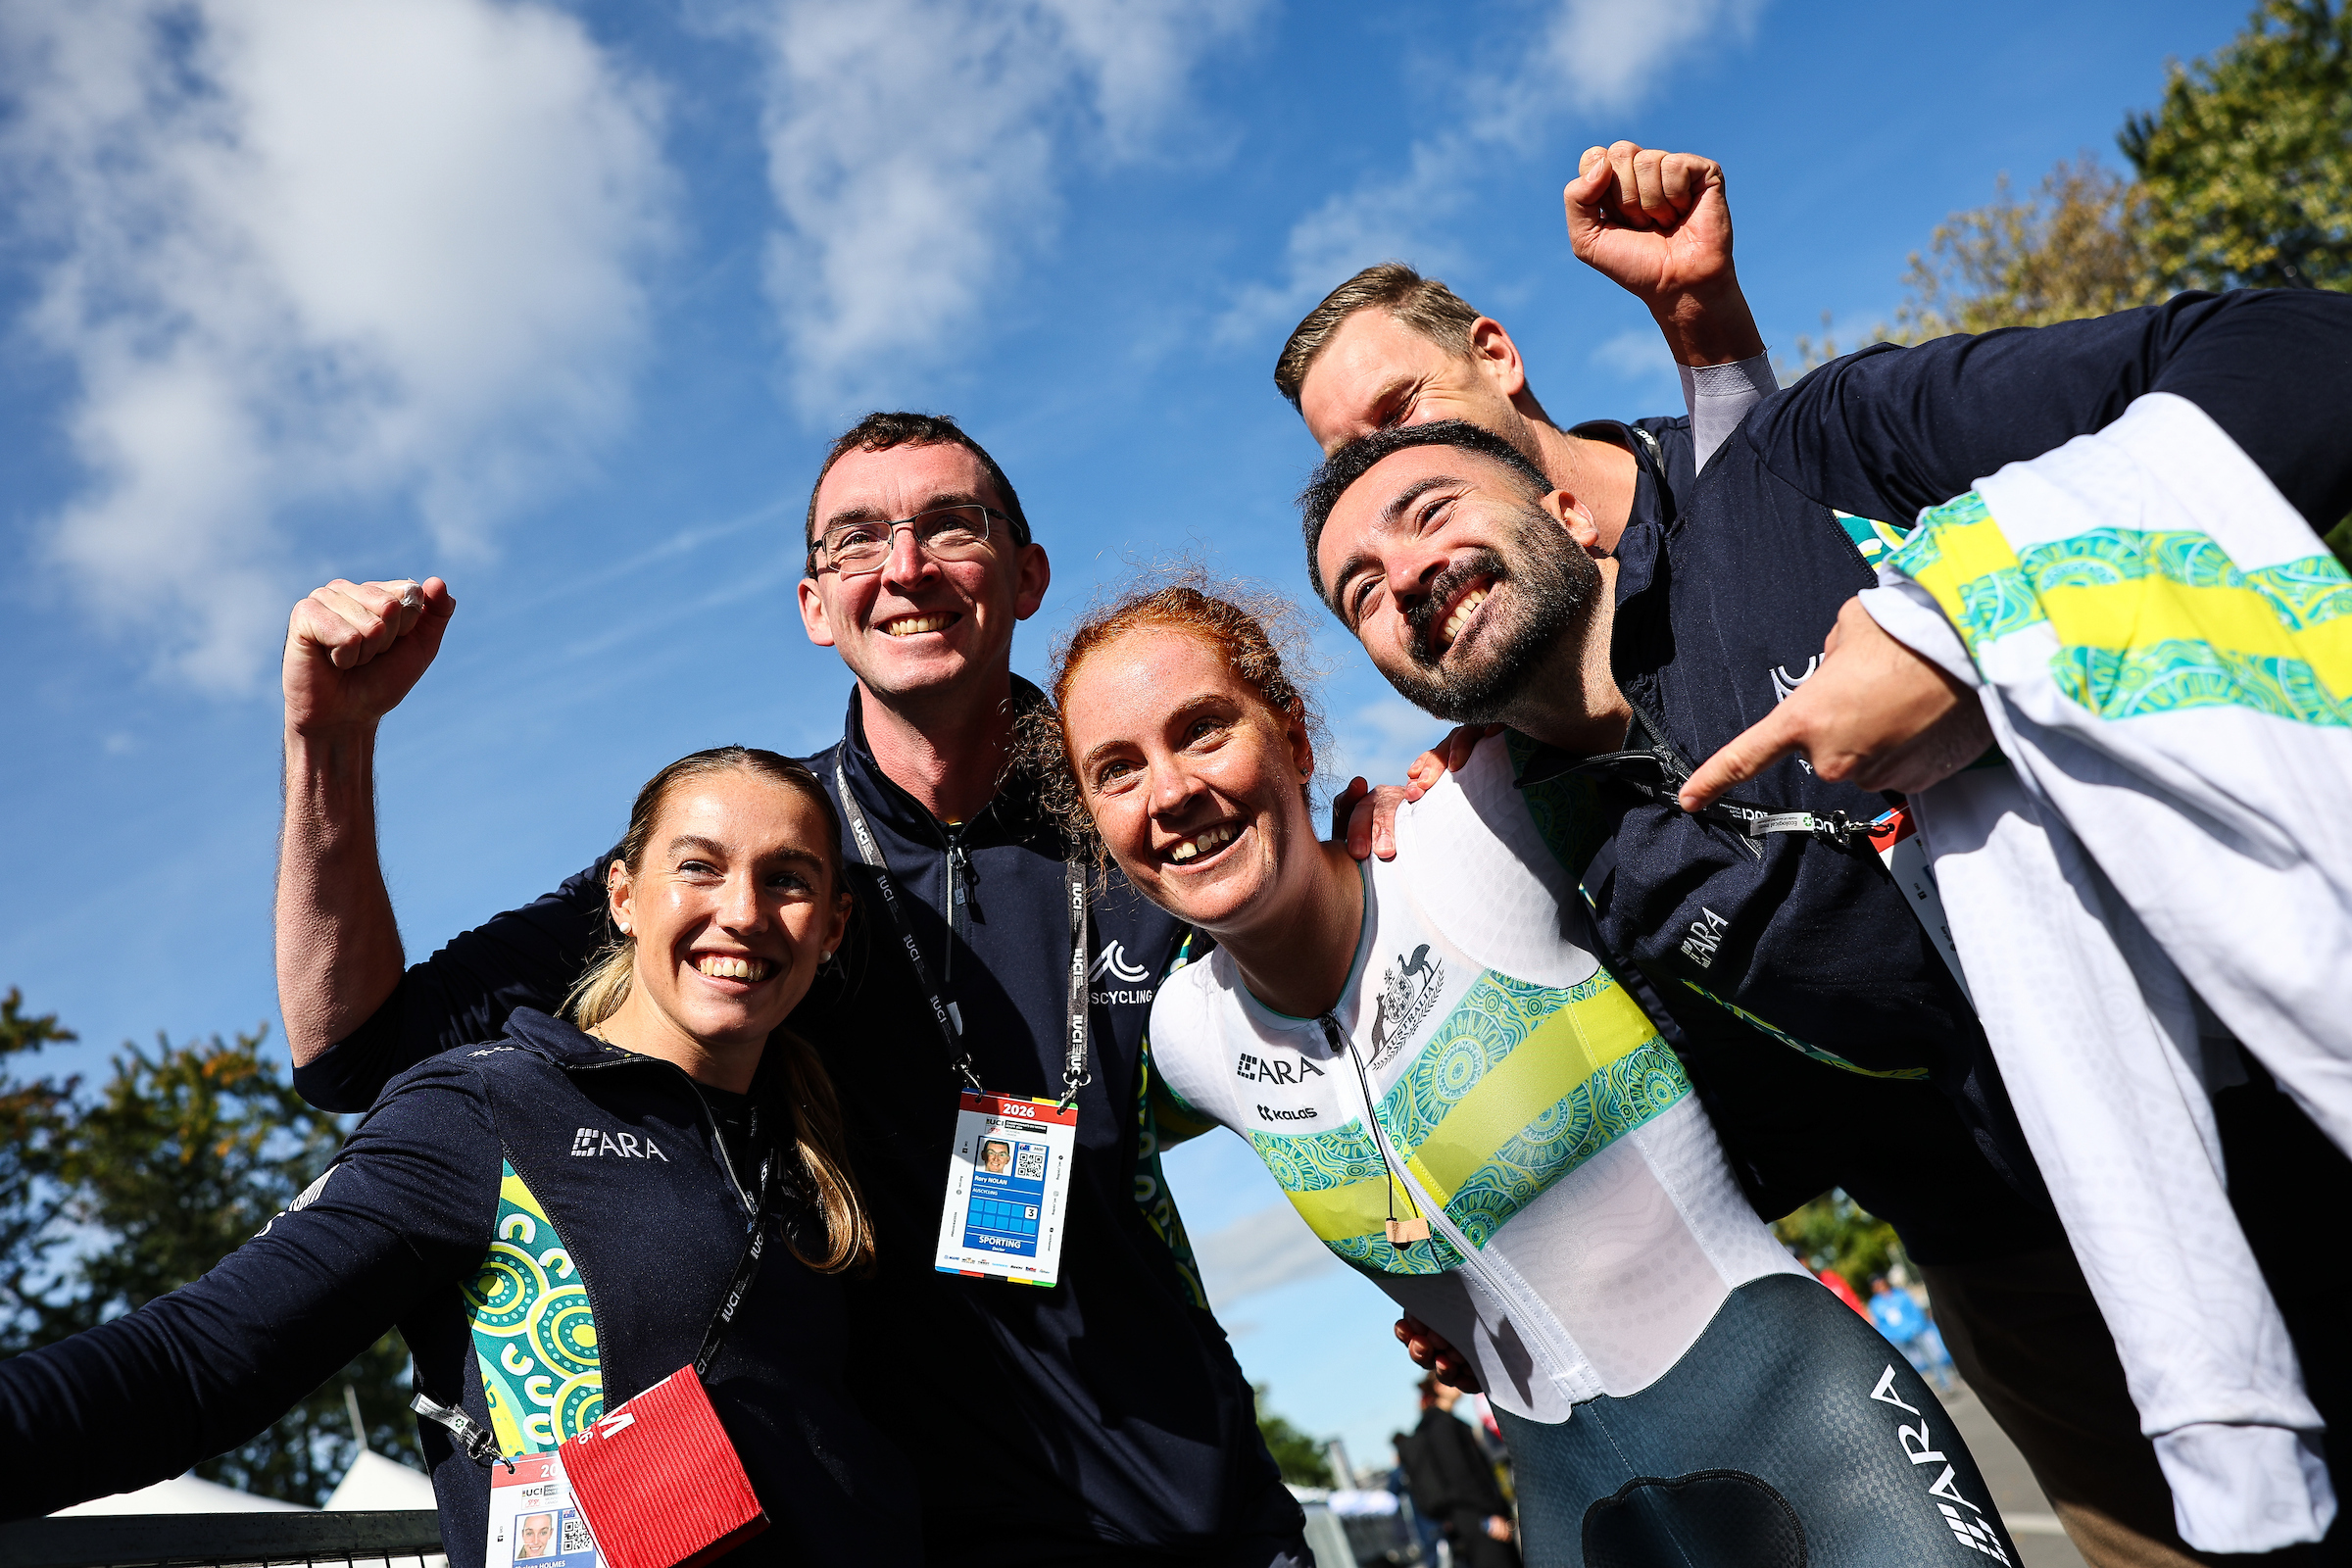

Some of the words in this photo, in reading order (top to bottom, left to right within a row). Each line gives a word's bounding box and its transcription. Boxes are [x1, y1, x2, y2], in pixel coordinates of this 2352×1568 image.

[856, 824, 870, 845] UCI
[1815, 818, 1835, 834] UC
[879, 879, 895, 902] UCI
[1072, 887, 1082, 909] UCI
[1687, 906, 1729, 961] ARA
[906, 938, 920, 961] UCI
[1072, 955, 1083, 976] UCI
[1091, 990, 1152, 1004] SCYCLING
[932, 998, 948, 1023] UCI
[1386, 986, 1435, 1055] AUSTRALIA
[1072, 1019, 1082, 1043] UCI
[1258, 1056, 1325, 1085] ARA
[1003, 1103, 1035, 1117] 2026
[600, 1132, 669, 1162] ARA
[1028, 1208, 1035, 1217] 3
[978, 1235, 1022, 1250] SPORTING
[725, 1291, 740, 1317] UCI
[697, 1358, 708, 1375] CI
[1870, 1363, 1982, 1515] ARA
[540, 1464, 559, 1478] 20
[525, 1488, 543, 1497] UCI
[539, 1559, 565, 1568] HOLMES
